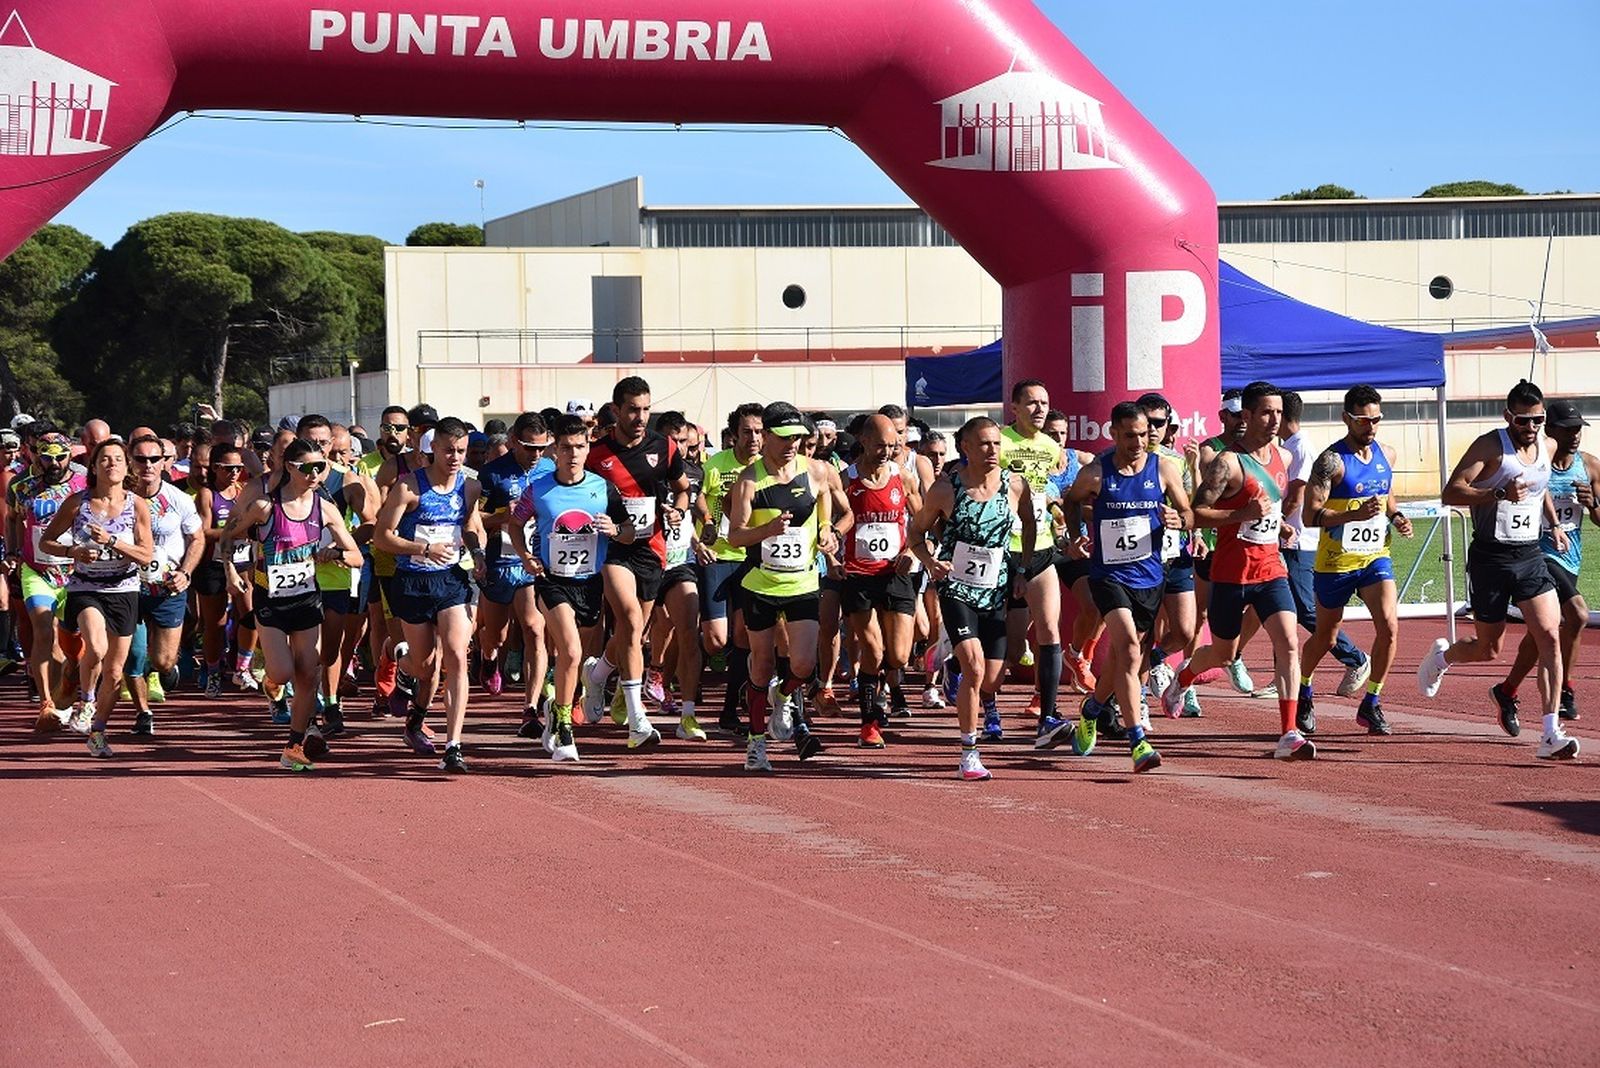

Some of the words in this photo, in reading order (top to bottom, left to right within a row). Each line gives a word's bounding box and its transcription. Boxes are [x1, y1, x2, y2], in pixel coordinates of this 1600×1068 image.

[309, 9, 517, 58] PUNTA
[539, 17, 772, 62] UMBRIA
[1070, 269, 1207, 392] iP
[1250, 518, 1278, 533] 234
[1511, 514, 1531, 529] 54
[1115, 534, 1139, 551] 45
[1351, 527, 1380, 542] 205
[770, 543, 802, 559] 233
[868, 537, 889, 552] 60
[557, 550, 590, 566] 252
[965, 561, 987, 577] 21
[275, 571, 307, 590] 232
